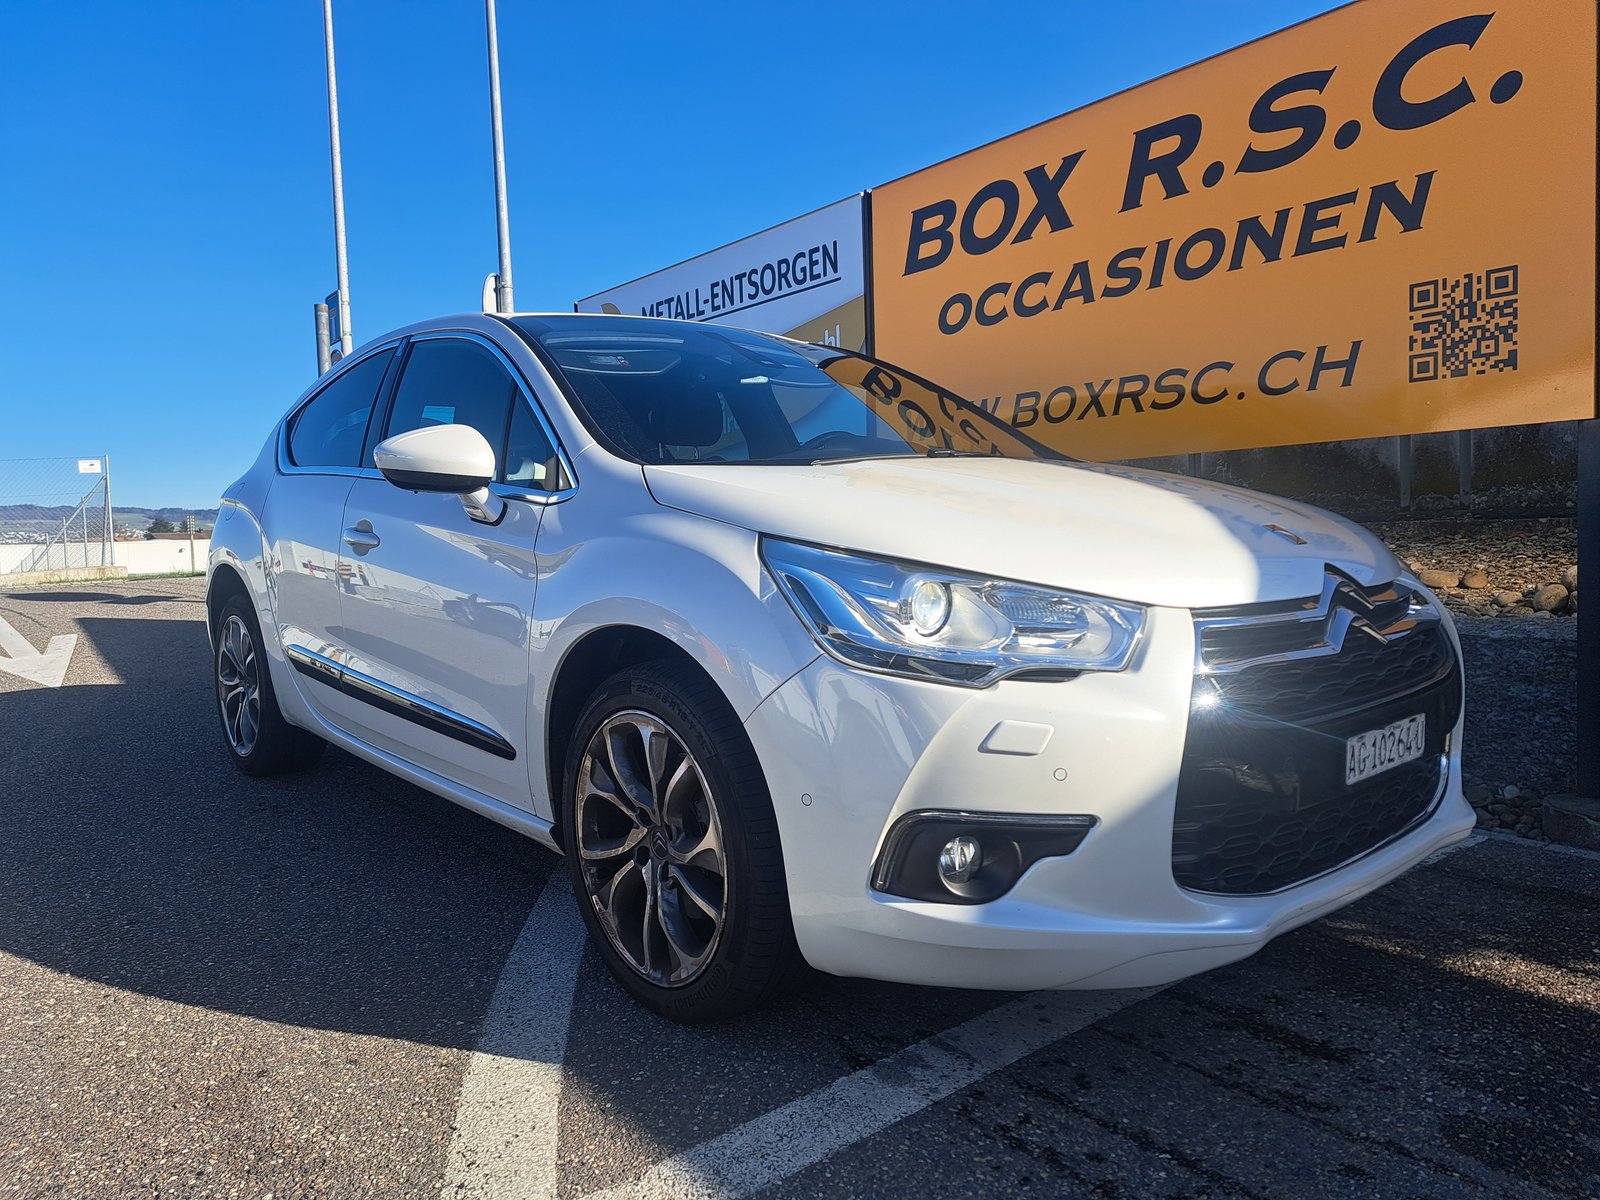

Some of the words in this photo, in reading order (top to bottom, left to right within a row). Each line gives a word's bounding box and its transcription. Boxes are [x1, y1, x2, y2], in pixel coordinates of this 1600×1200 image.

[902, 149, 1087, 278] BOX
[1118, 11, 1524, 214] R.S.C.
[938, 169, 1438, 336] OCCASIONEN
